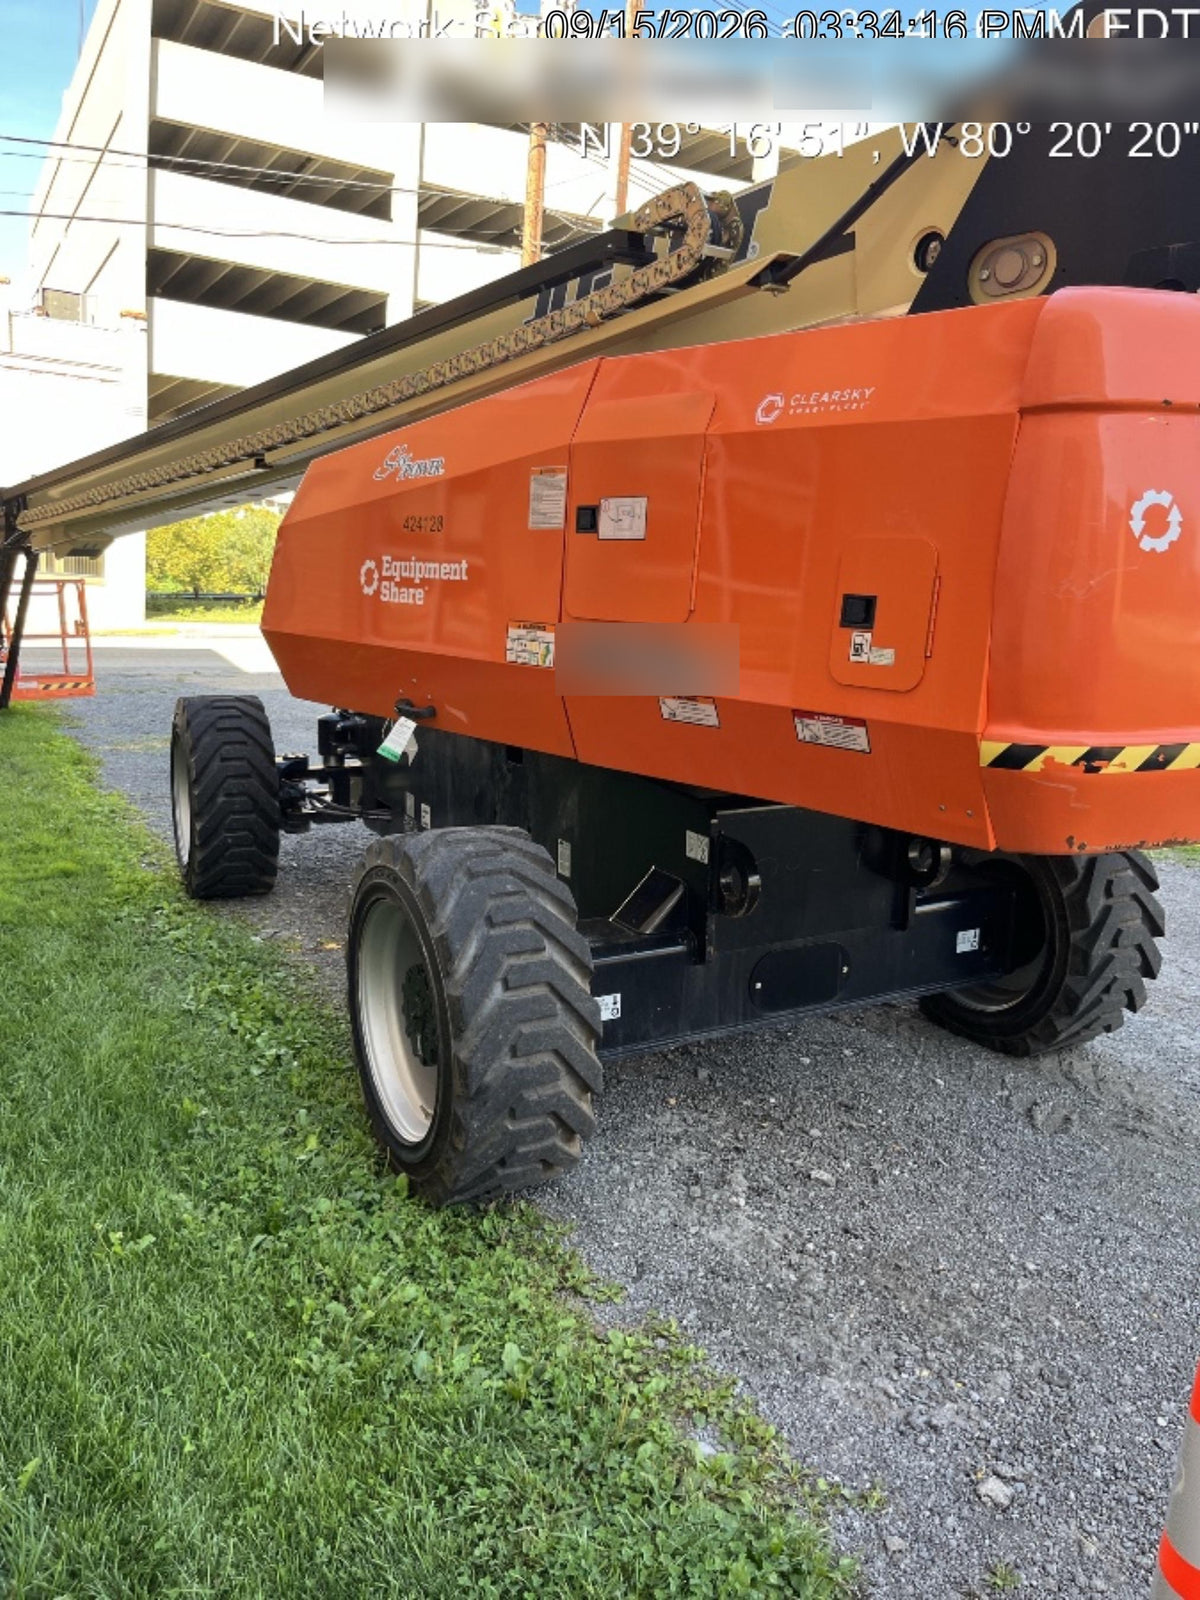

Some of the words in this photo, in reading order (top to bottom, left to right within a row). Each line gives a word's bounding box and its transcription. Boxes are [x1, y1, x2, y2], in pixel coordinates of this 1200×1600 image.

[790, 387, 876, 406] CLEARSKY
[382, 556, 468, 583] Equipment
[380, 581, 424, 605] Share
